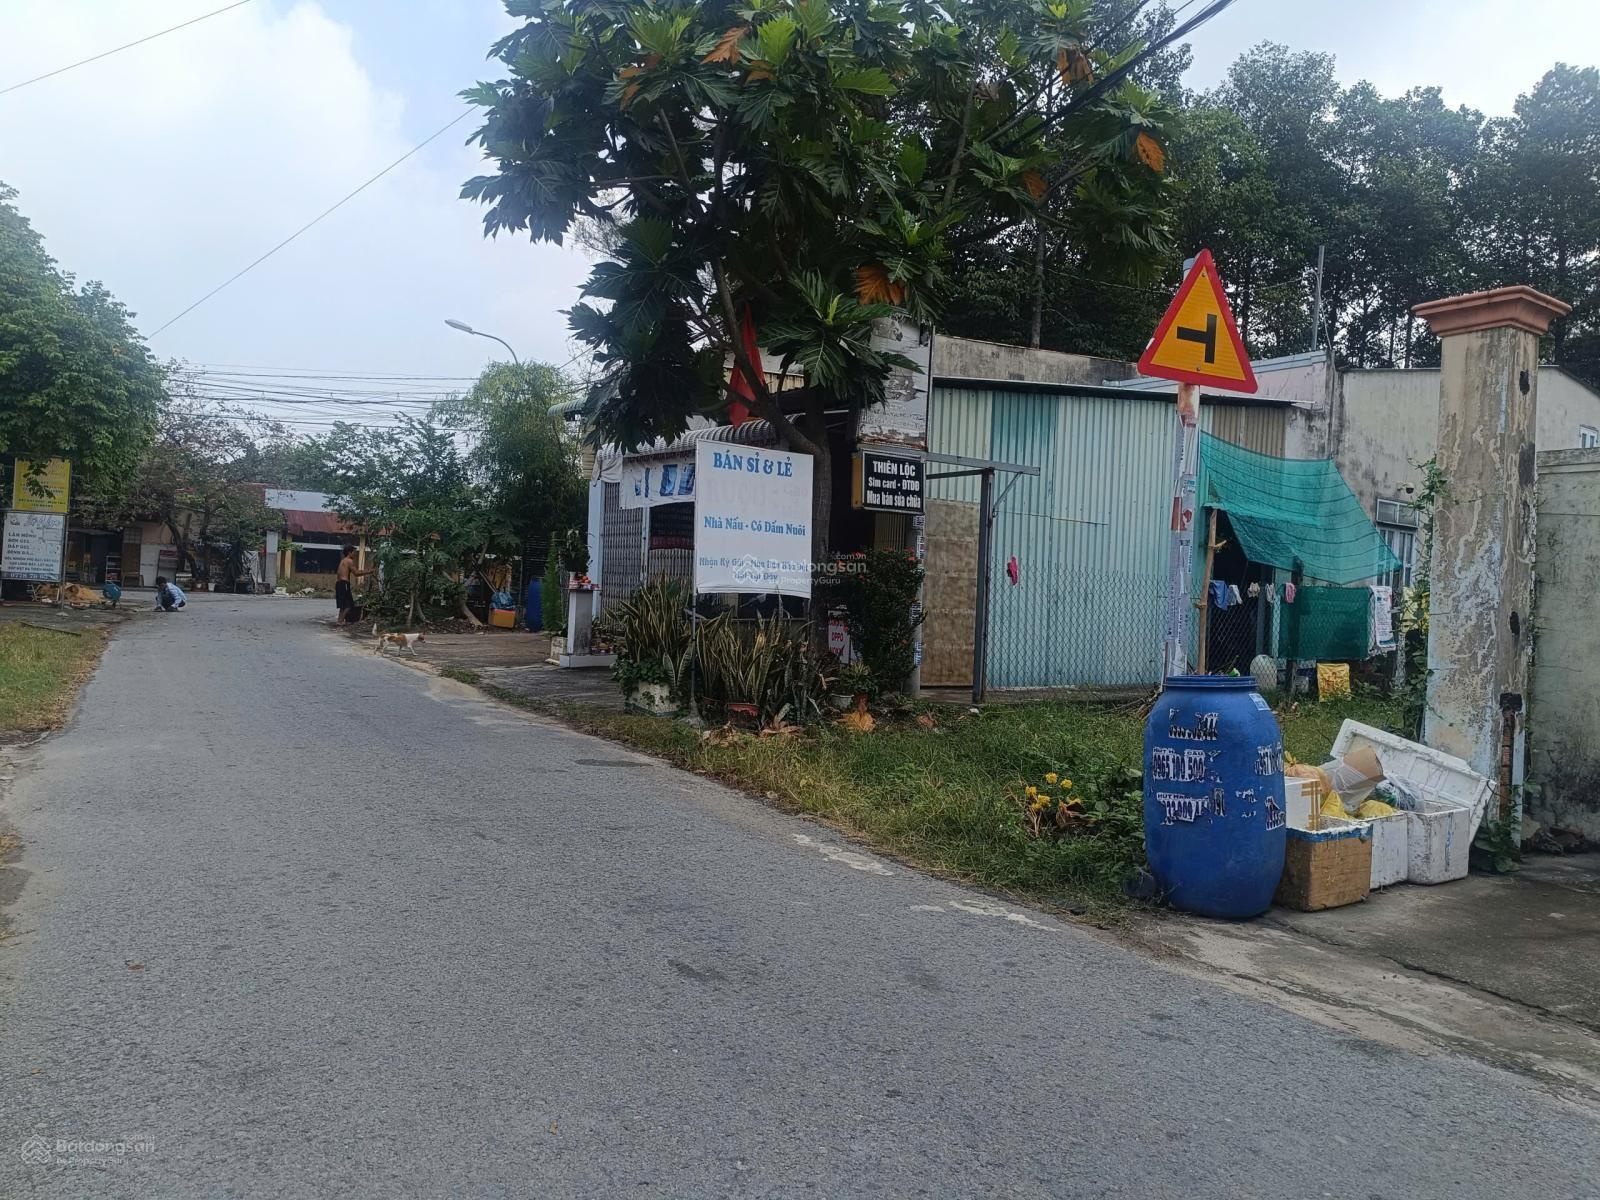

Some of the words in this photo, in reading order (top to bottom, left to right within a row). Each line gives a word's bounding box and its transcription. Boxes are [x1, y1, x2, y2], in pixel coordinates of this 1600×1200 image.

[713, 450, 743, 471] BÁN
[747, 452, 760, 473] SỈ
[763, 459, 774, 474] &
[777, 456, 793, 478] LẺ
[873, 460, 898, 475] THIÊN
[899, 462, 916, 479] LỘC
[868, 476, 881, 488] Sim
[882, 479, 897, 489] card
[866, 490, 880, 504] Mua
[881, 491, 893, 506] bán
[894, 491, 906, 507] sửa
[906, 494, 921, 508] chữa
[704, 516, 723, 529] Nhà
[725, 516, 744, 530] Nấu
[751, 519, 762, 532] Có
[764, 520, 784, 534] Dấm
[786, 523, 806, 536] Nuôi
